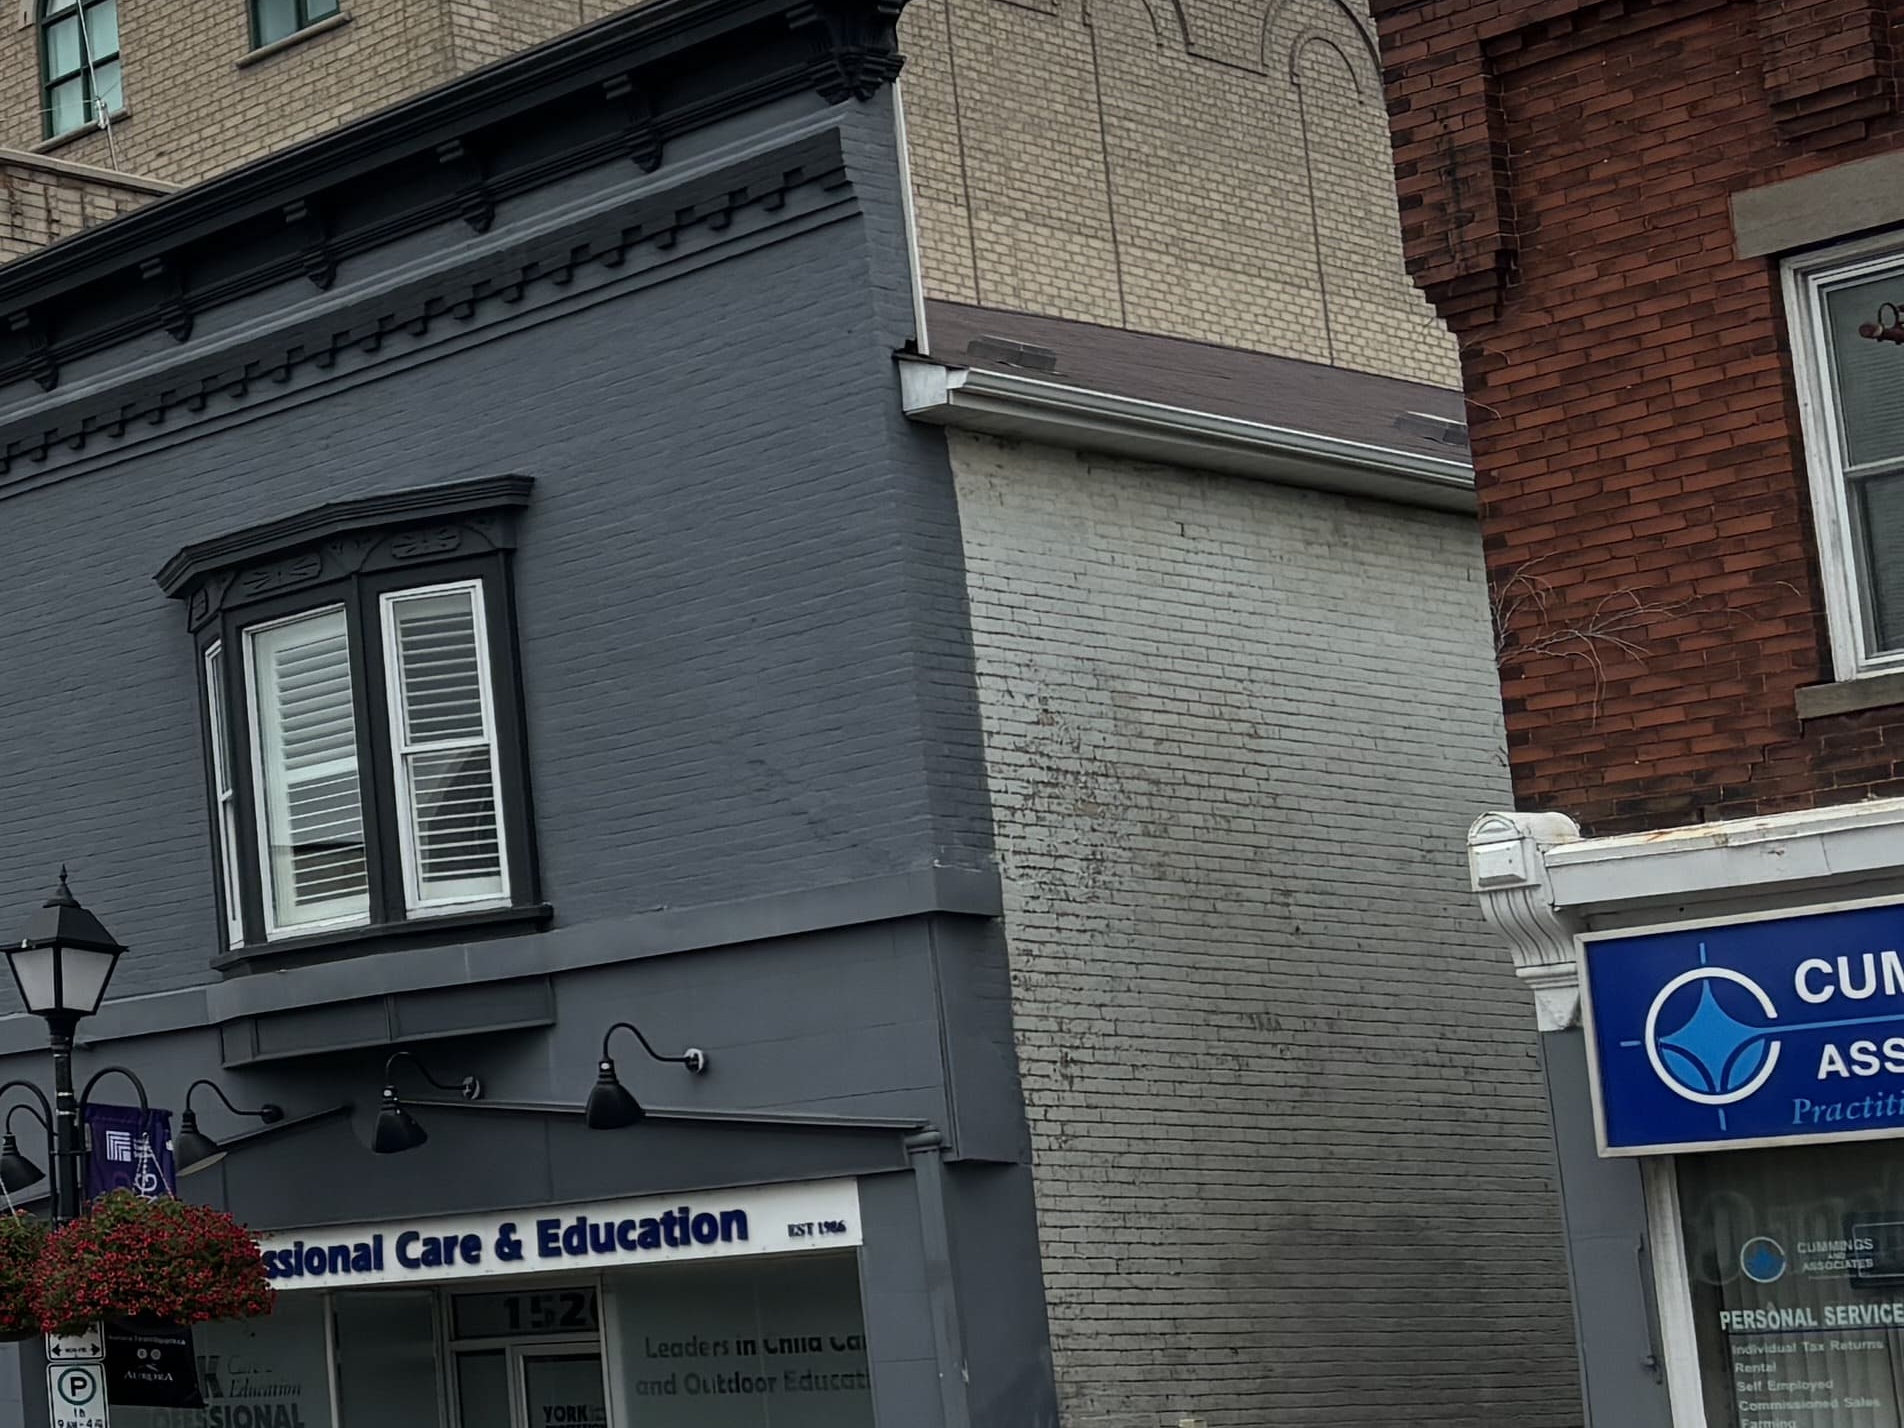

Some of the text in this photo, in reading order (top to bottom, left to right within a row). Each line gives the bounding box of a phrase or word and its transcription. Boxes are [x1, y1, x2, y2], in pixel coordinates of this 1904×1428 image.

[1817, 1037, 1904, 1080] ASS
[395, 1230, 482, 1269] Care
[494, 1222, 524, 1262] &
[536, 1206, 749, 1257] Education
[787, 1223, 814, 1238] EST
[1796, 1238, 1874, 1254] CUMMINGS
[1802, 1259, 1874, 1272] ASSOCIATES
[1719, 1302, 1904, 1331] PERSONAL SERVICE
[645, 1335, 730, 1359] Leaders
[735, 1334, 758, 1356] in
[1732, 1339, 1885, 1355] Individual Tax Returns
[1734, 1362, 1777, 1373] Rental
[634, 1374, 678, 1397] and
[683, 1372, 779, 1397] Outdoor
[1736, 1379, 1834, 1393] Self Employed
[1738, 1396, 1881, 1412] Commissioned Sales
[542, 1403, 588, 1423] YORK
